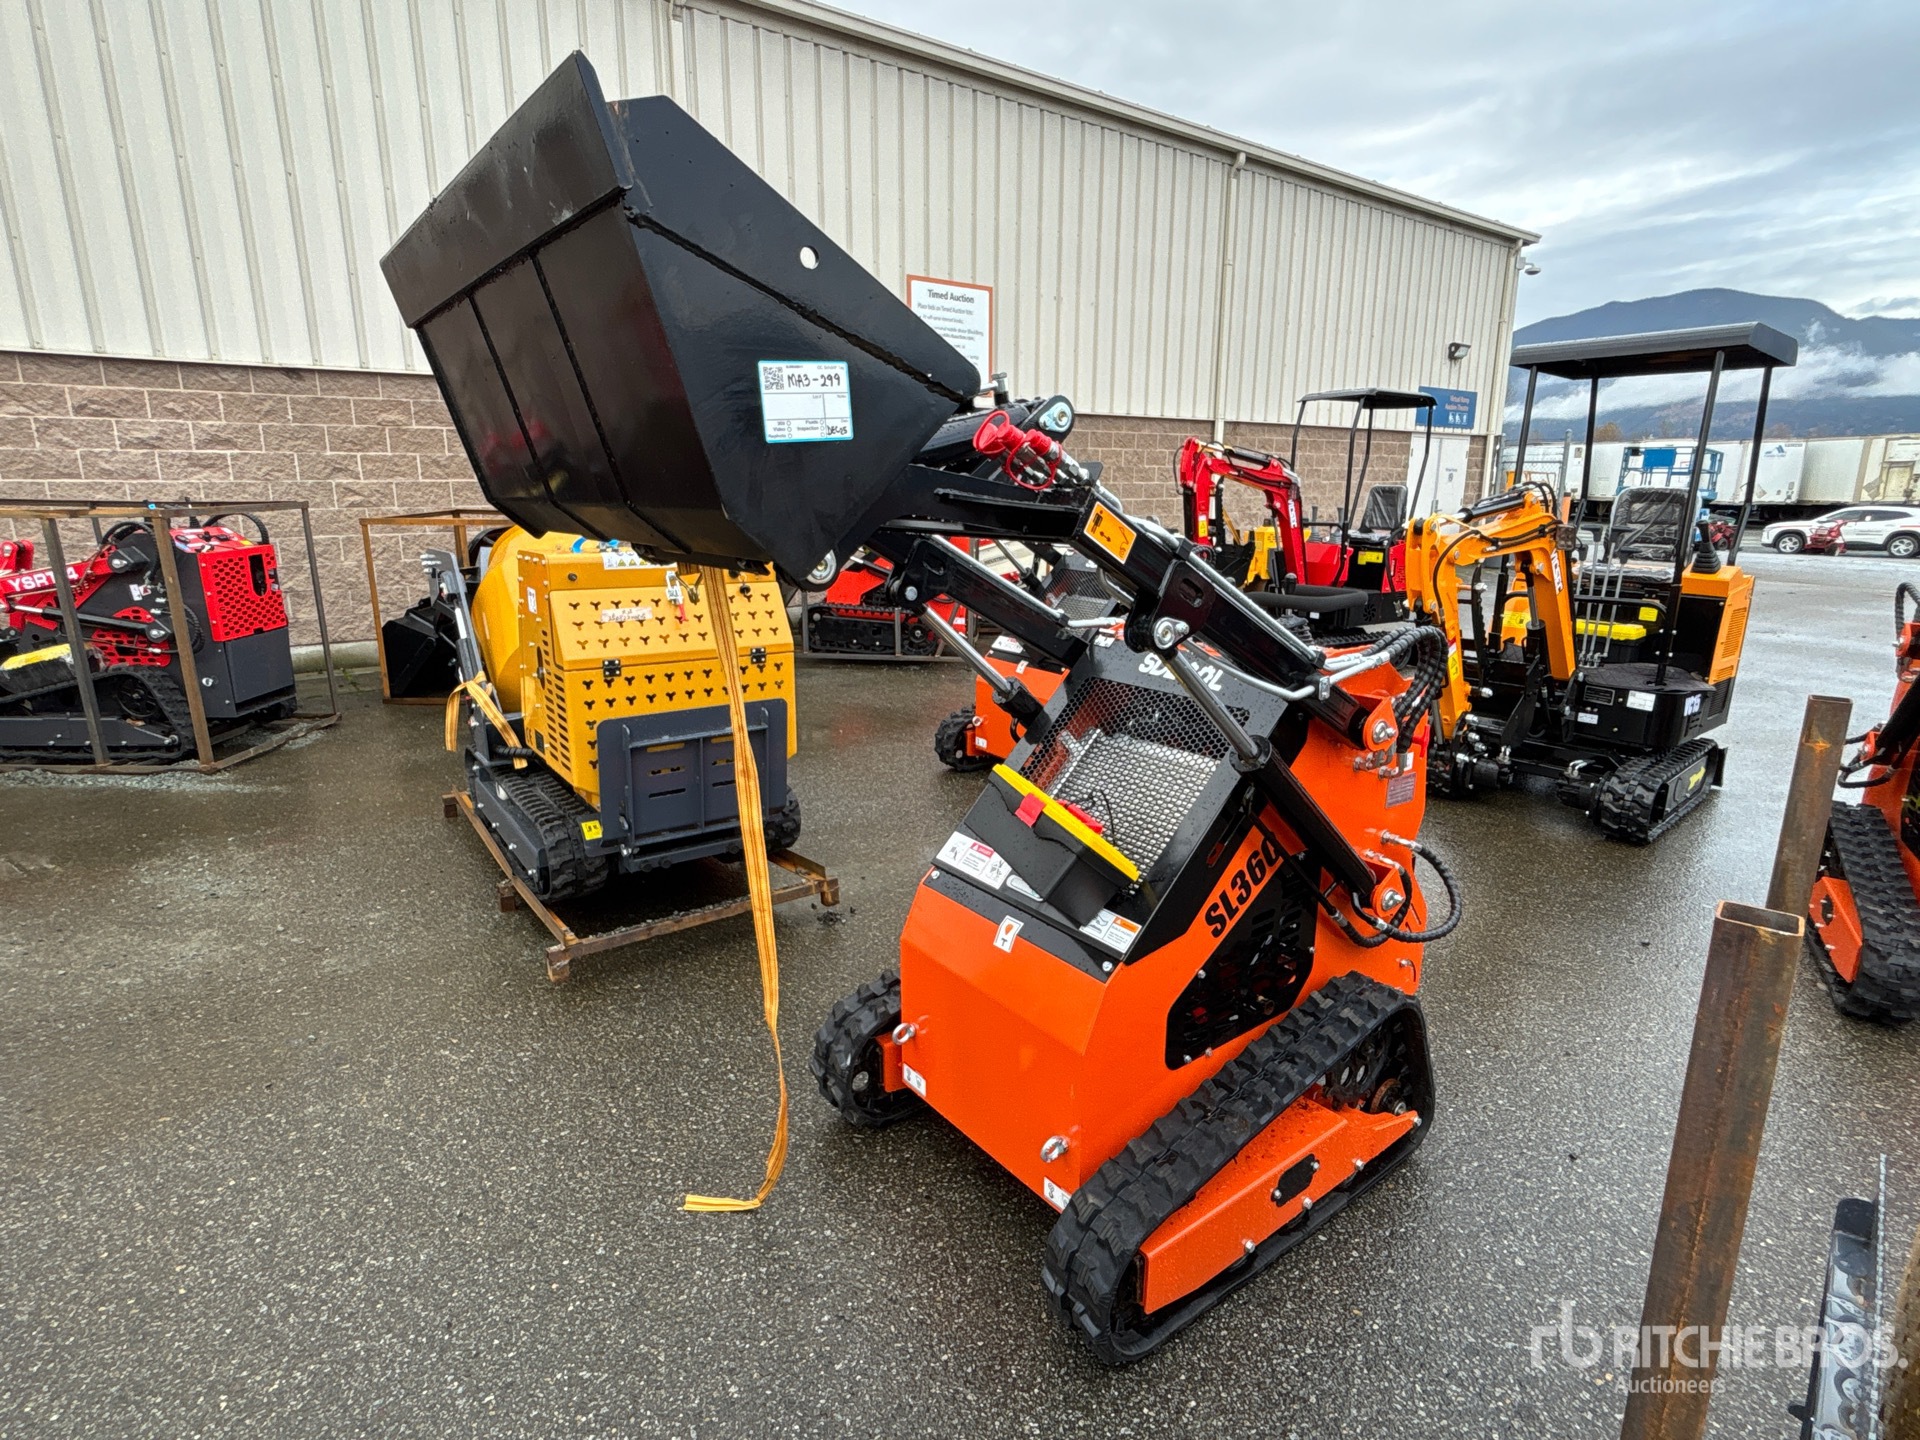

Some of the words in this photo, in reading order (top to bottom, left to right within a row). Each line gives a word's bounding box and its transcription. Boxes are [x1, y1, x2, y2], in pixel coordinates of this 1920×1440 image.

[927, 289, 949, 300] Timed
[949, 293, 975, 304] Auction
[787, 373, 841, 388] MA3-299
[8, 566, 79, 592] YSRT4
[1204, 837, 1281, 938] SL360
